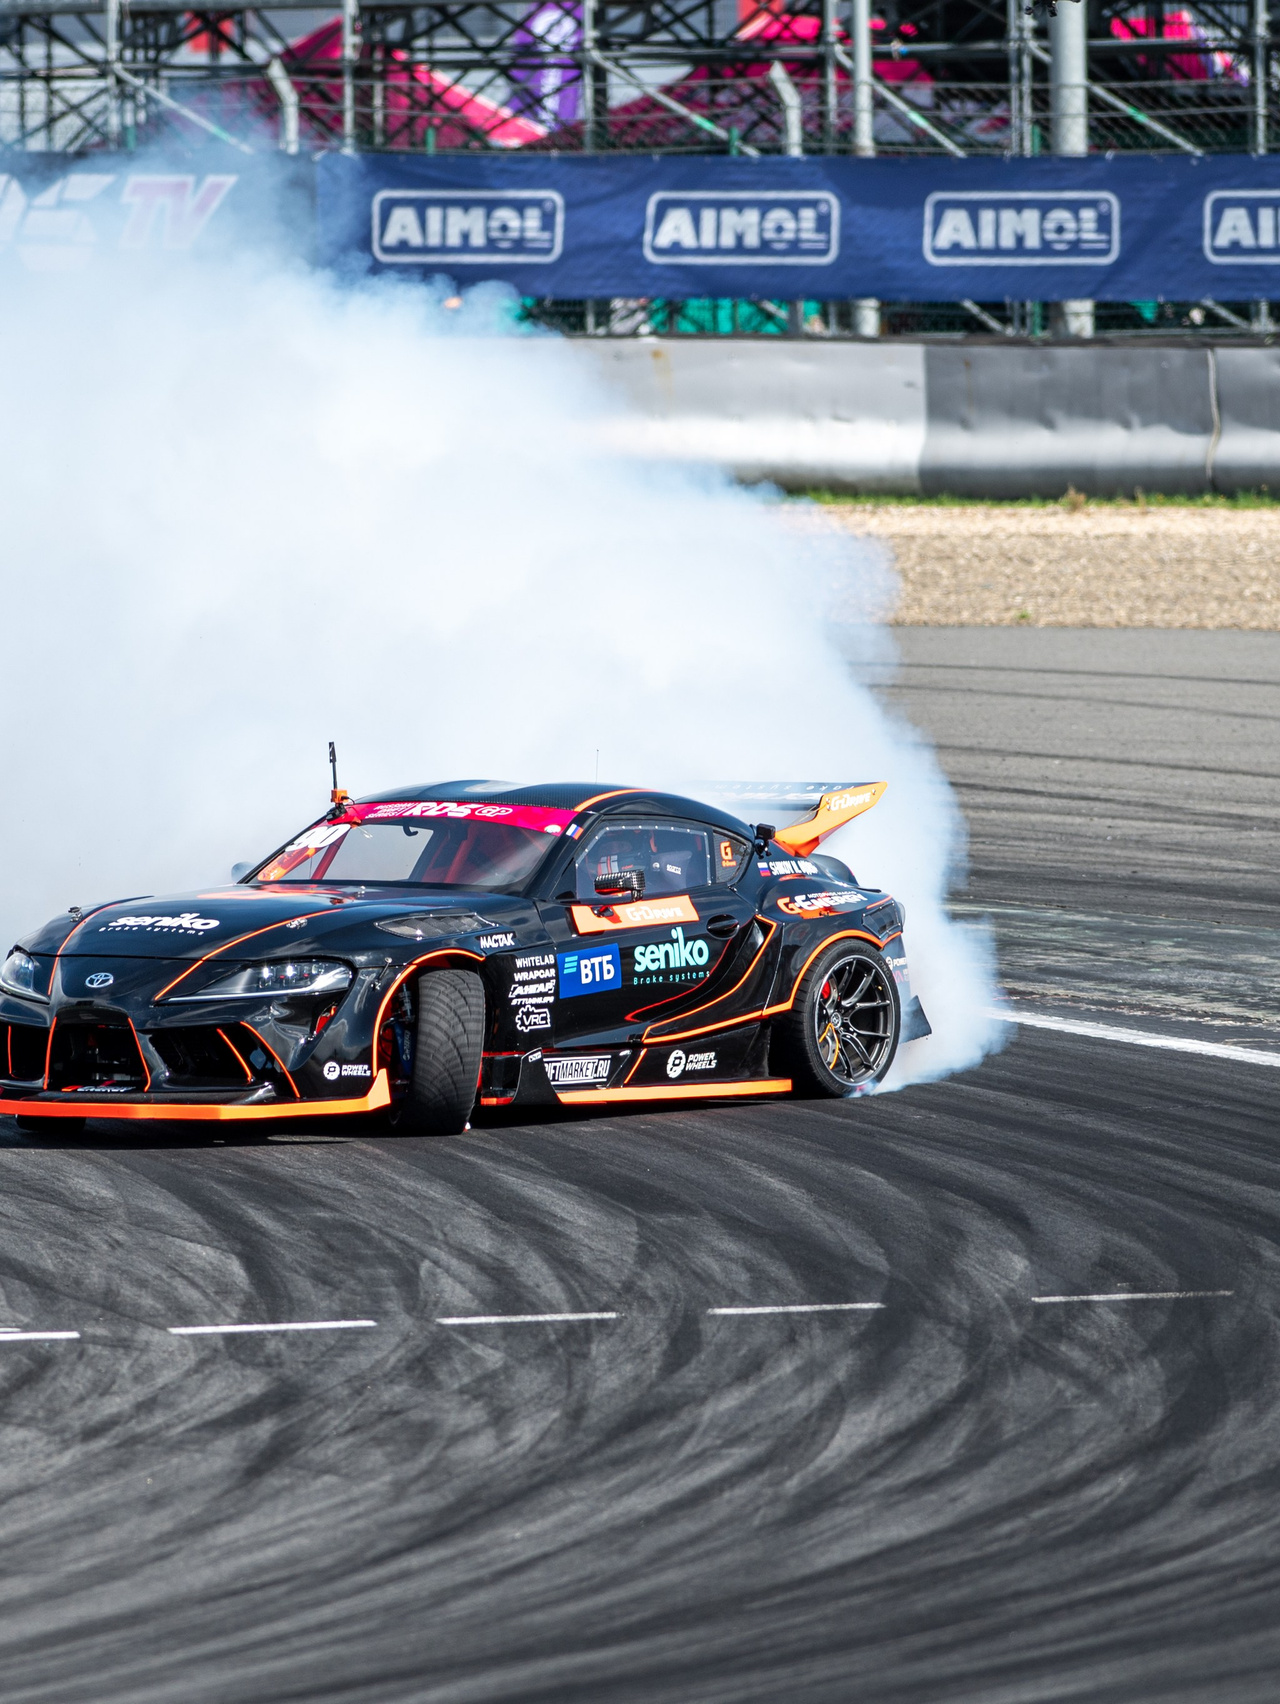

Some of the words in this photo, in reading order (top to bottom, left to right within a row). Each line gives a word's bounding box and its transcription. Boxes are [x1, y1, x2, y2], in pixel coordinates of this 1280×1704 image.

[121, 174, 238, 252] TV
[381, 206, 554, 248] AIMOL
[653, 206, 829, 249] AIMOL
[934, 206, 1110, 250] AIMOL
[1213, 207, 1280, 249] AI
[402, 802, 483, 818] RDS
[475, 805, 513, 817] GP
[285, 823, 351, 852] 90
[108, 912, 220, 930] seniko
[634, 927, 710, 972] seniko
[515, 954, 555, 968] WHITELAB
[579, 954, 615, 984] ВТБ
[514, 968, 556, 982] WRAPCAR
[669, 971, 710, 983] systems
[523, 1013, 546, 1025] VRC
[685, 1059, 717, 1071] WHEELS
[687, 1051, 716, 1063] POWER
[543, 1060, 611, 1081] IFTMARKET.RU
